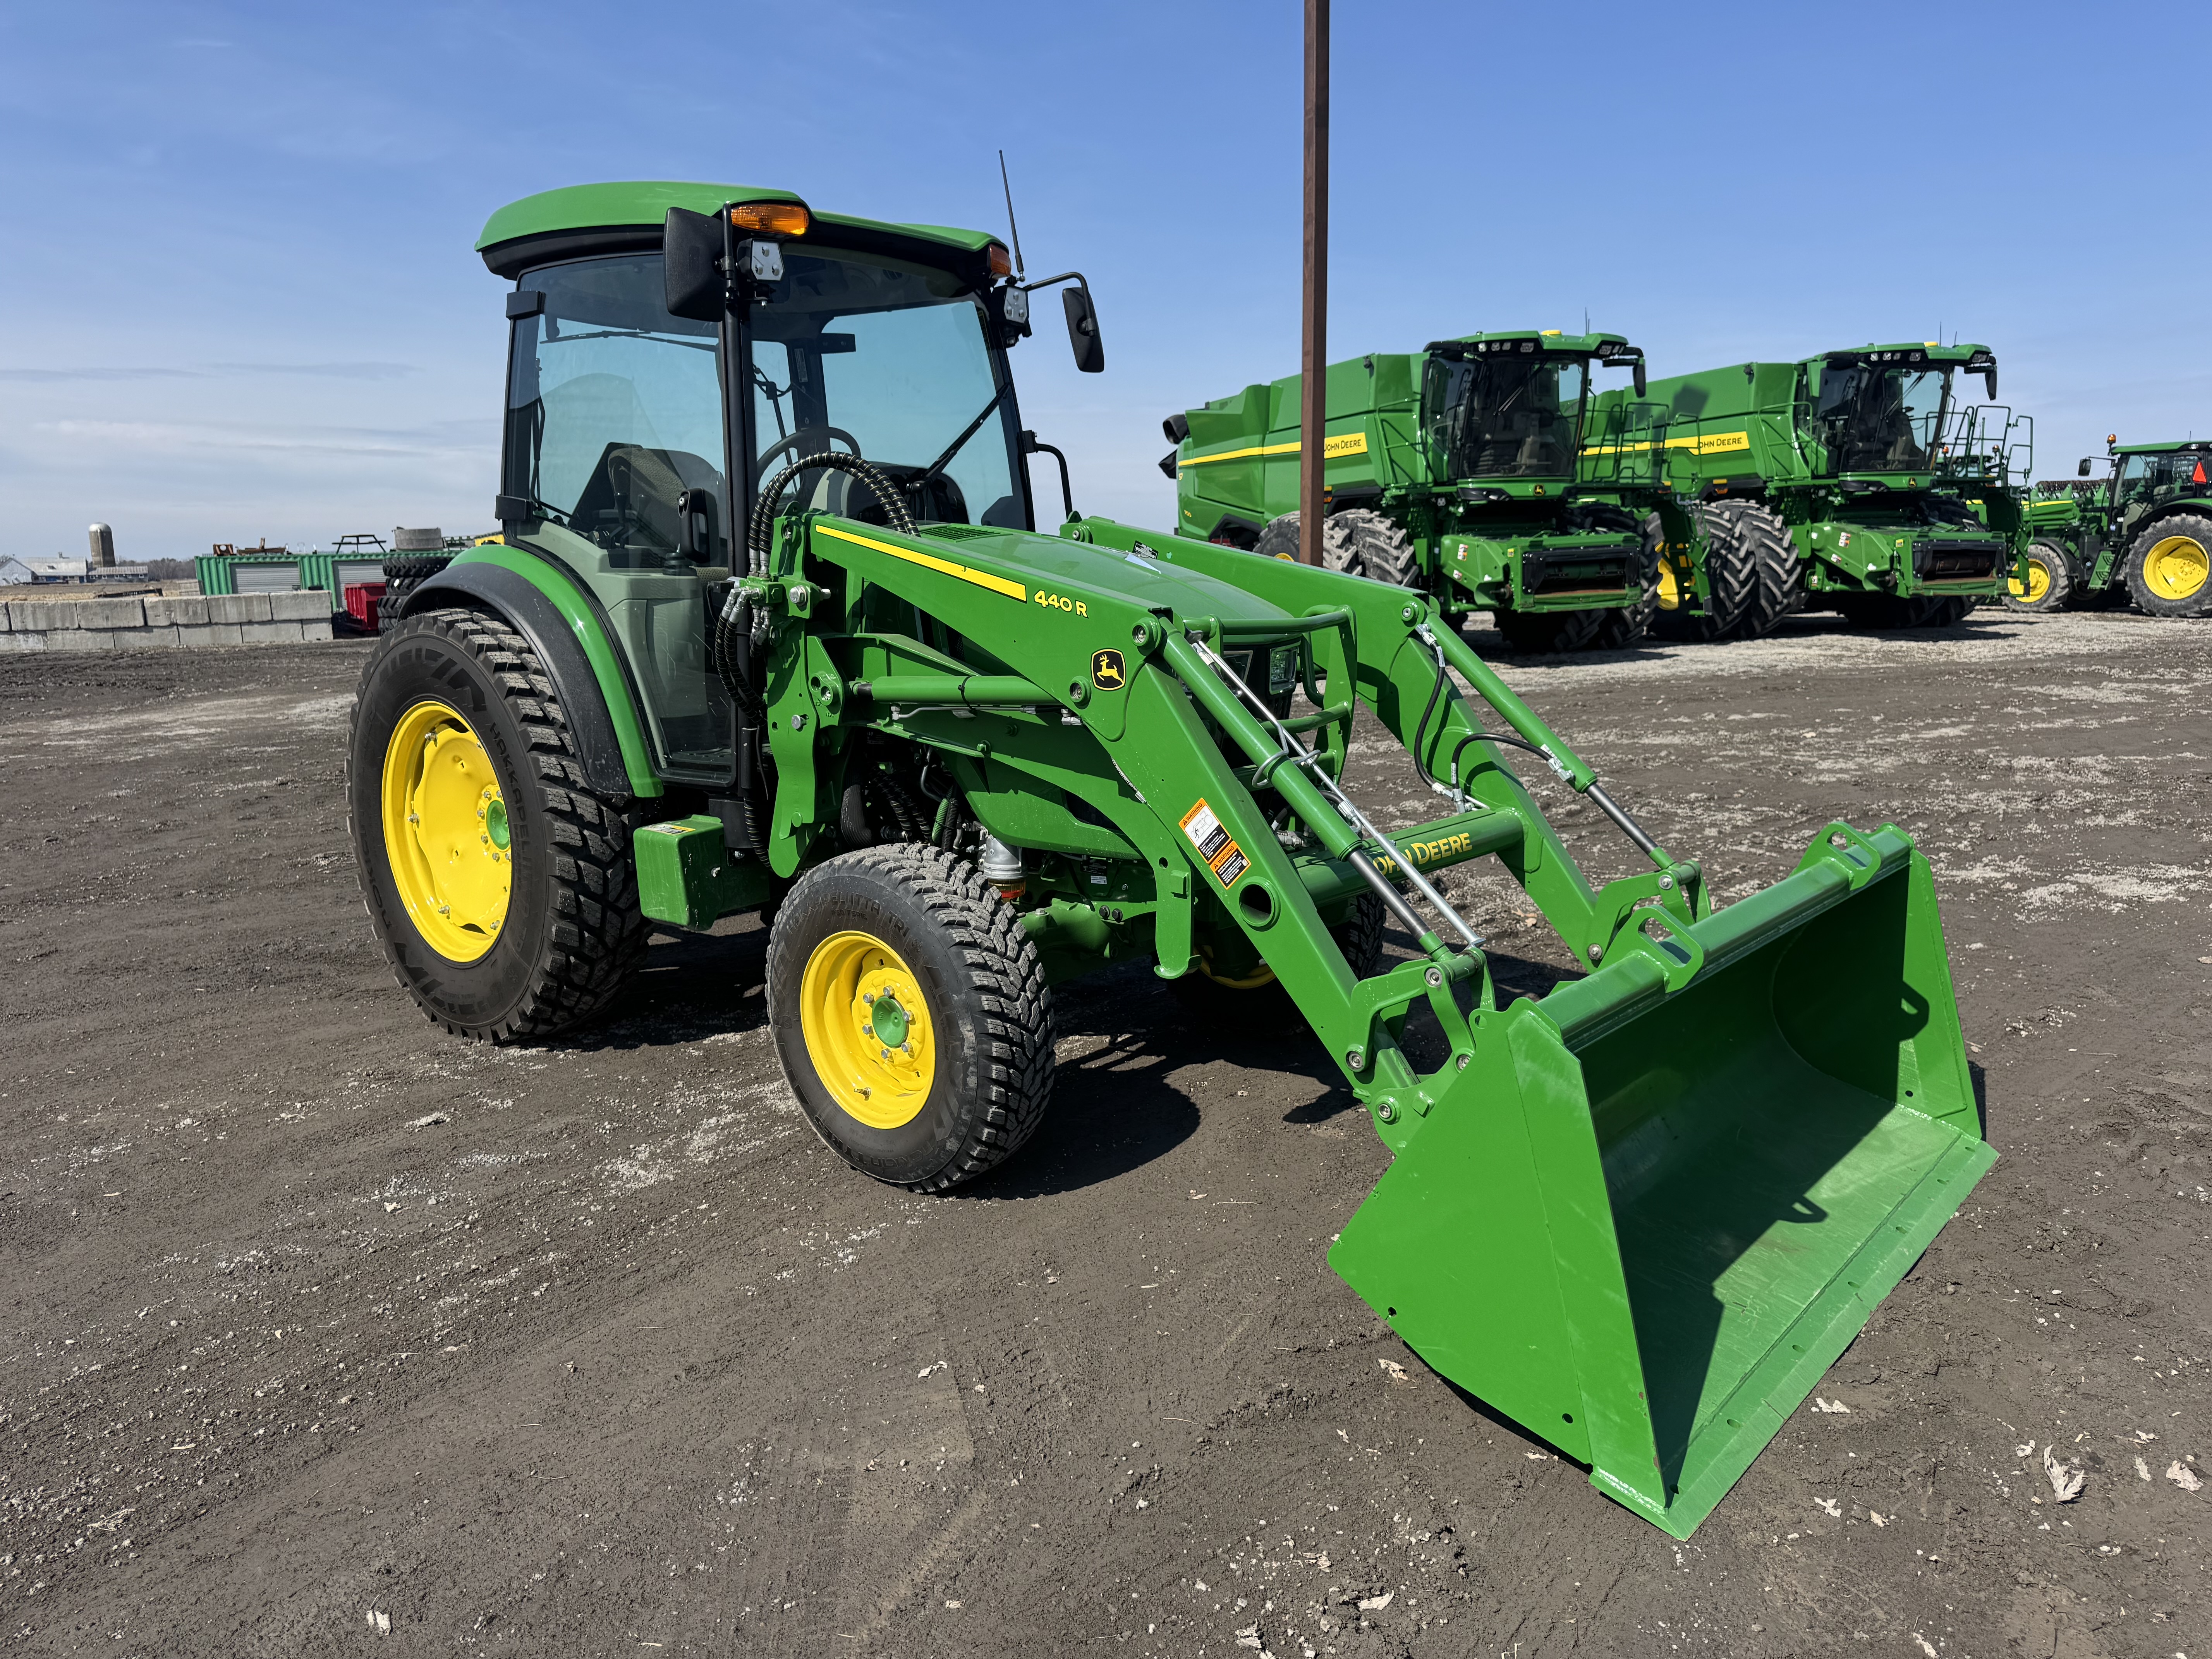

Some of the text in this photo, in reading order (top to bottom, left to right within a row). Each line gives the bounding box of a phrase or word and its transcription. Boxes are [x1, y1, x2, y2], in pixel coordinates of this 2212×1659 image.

[1324, 439, 1361, 452] JOHN DEERE
[1700, 437, 1742, 448] OHN DEERE
[1034, 589, 1089, 618] 440 R
[1187, 802, 1203, 821] WARNING
[1218, 845, 1235, 864] WARNING
[1372, 833, 1472, 875] OHN DEERE
[889, 910, 910, 939] TRI
